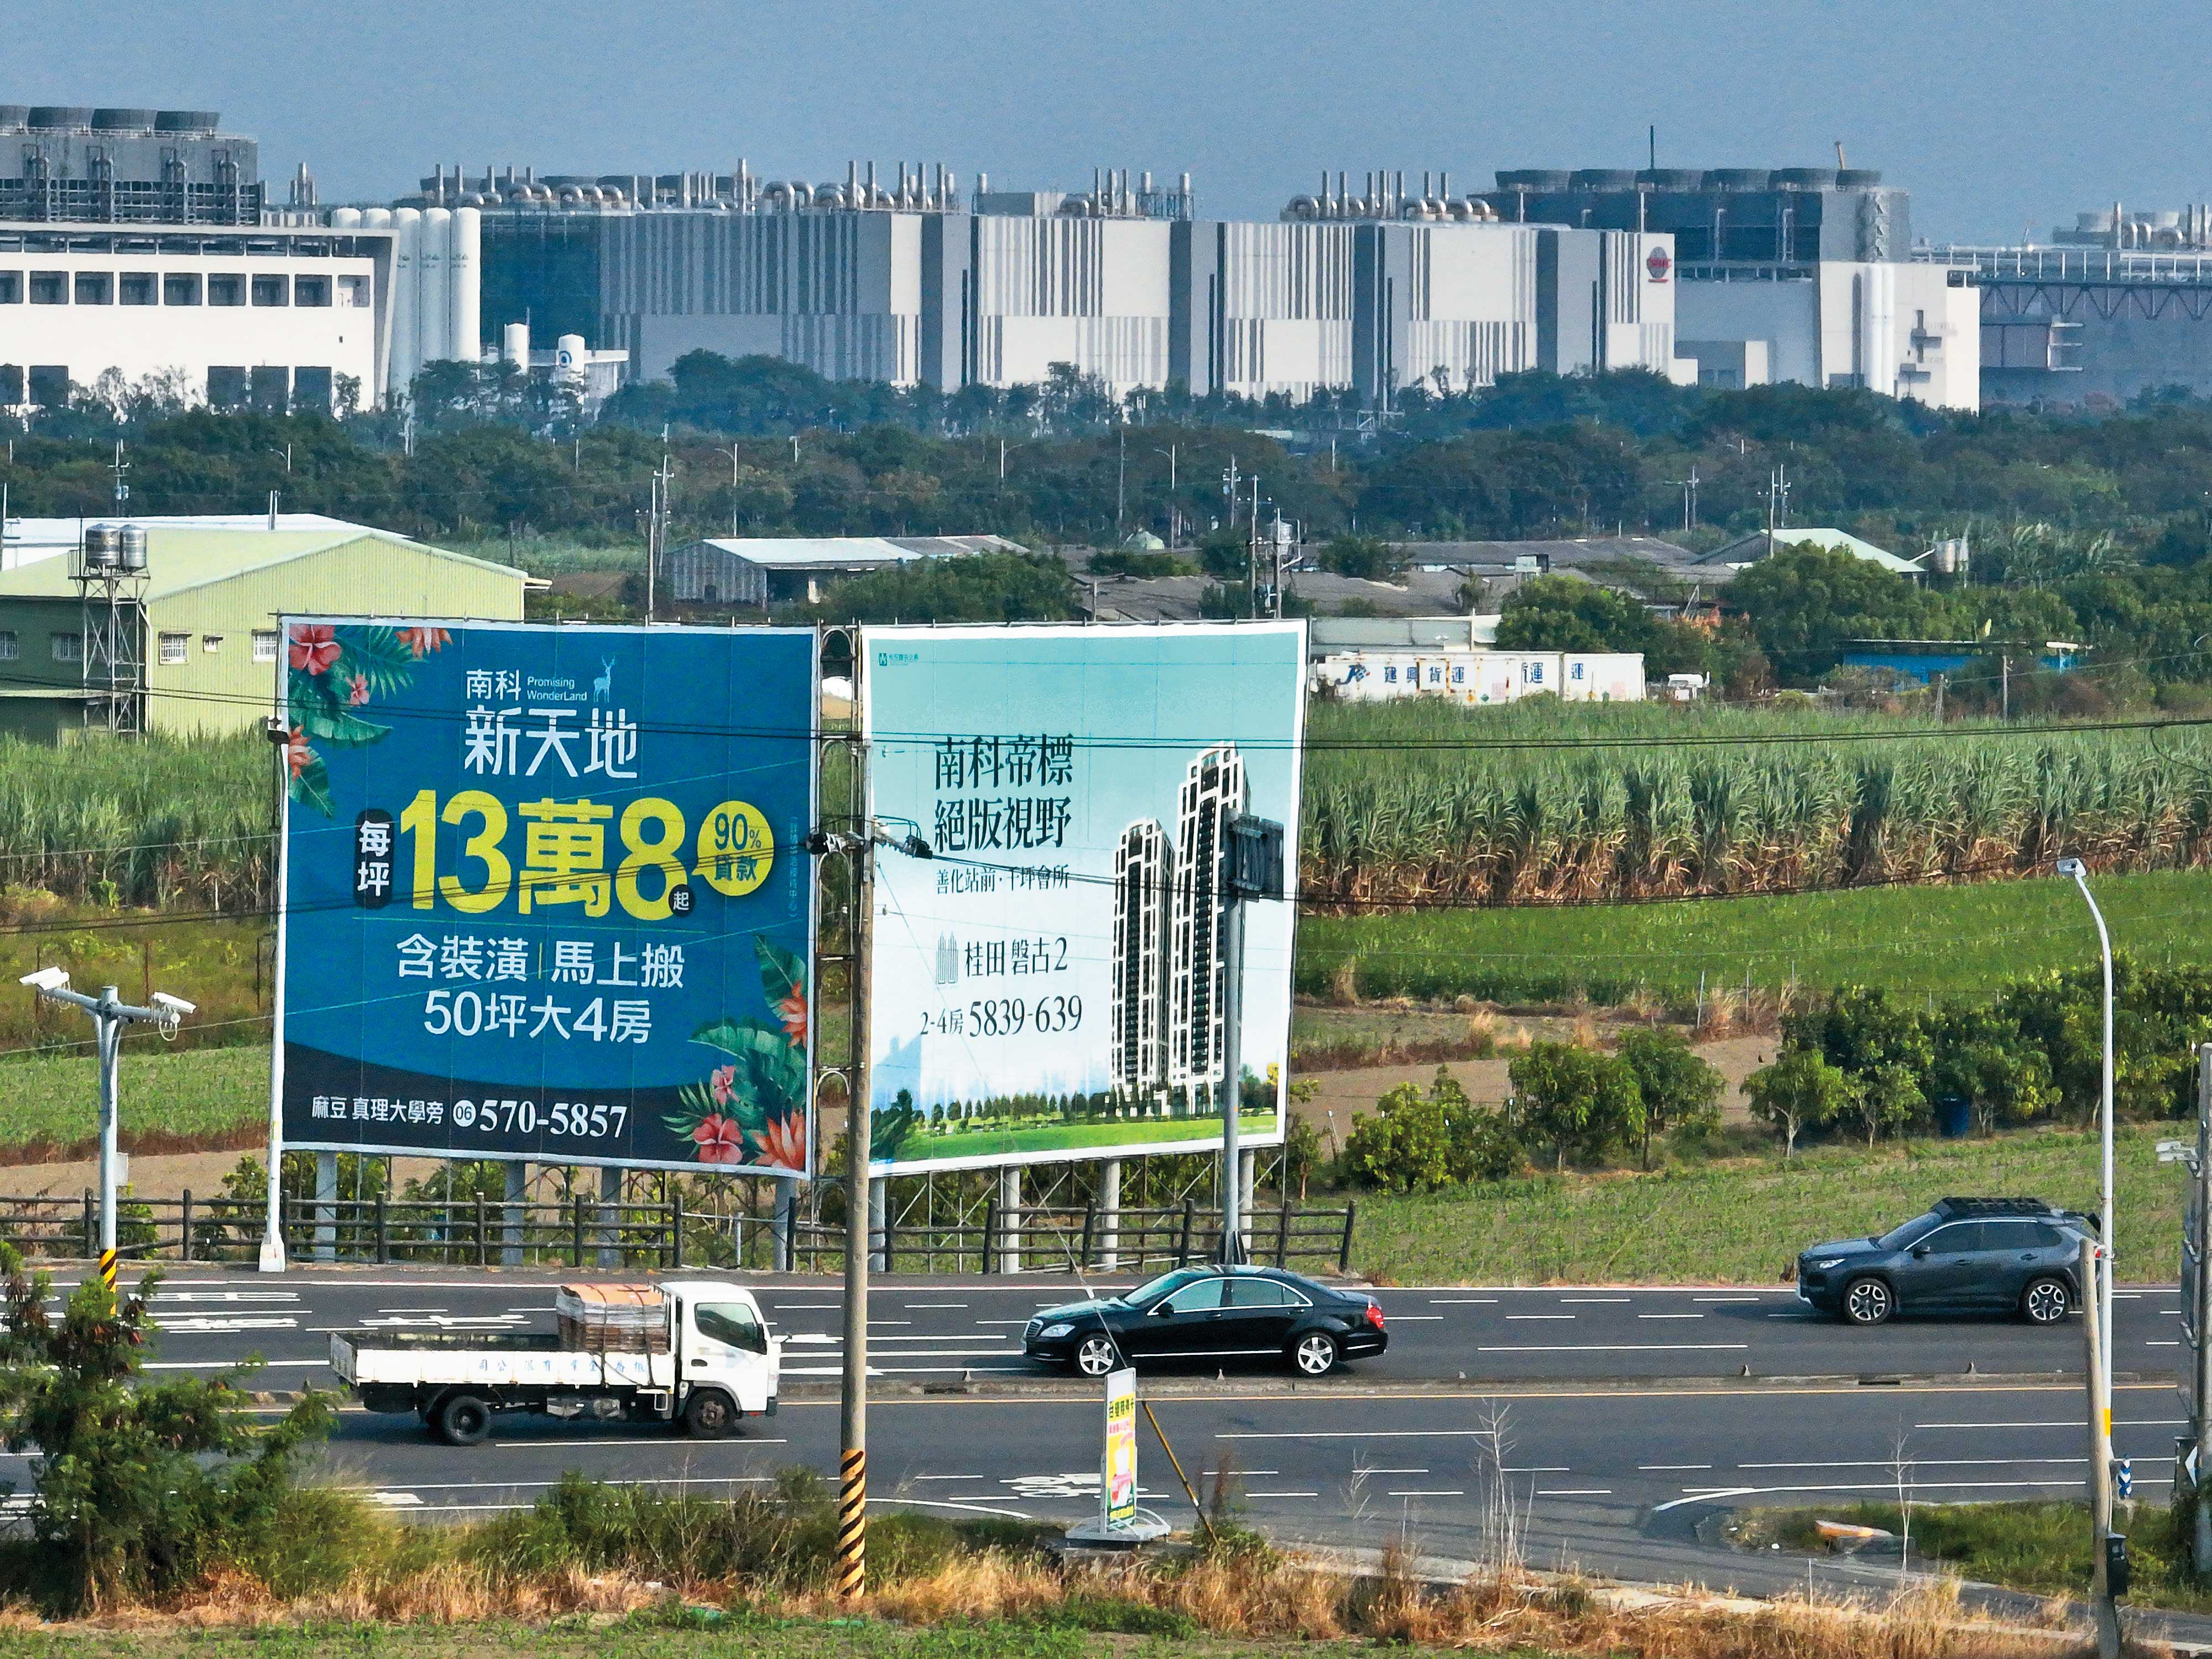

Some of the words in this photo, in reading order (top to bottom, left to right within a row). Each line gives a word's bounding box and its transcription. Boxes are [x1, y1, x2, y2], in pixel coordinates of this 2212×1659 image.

[466, 669, 521, 701] 南科
[527, 676, 575, 690] Promising
[527, 690, 587, 701] WonderLand
[464, 705, 638, 779] 新天地
[935, 733, 1073, 791] 南科帝標
[714, 813, 763, 852] 90%
[934, 795, 1072, 853] 絕版視野
[357, 820, 393, 898] 每坪
[400, 789, 686, 921] 13萬8
[673, 890, 691, 912] 起
[713, 853, 758, 883] 貸款
[396, 932, 529, 984] 含裝潢
[551, 940, 685, 990] 馬上搬
[423, 990, 653, 1044] 50坪大4房
[920, 1008, 964, 1036] 2-4房
[969, 995, 1083, 1037] 5839-639
[312, 1095, 348, 1119] 麻豆
[352, 1097, 444, 1125] 真理大學旁
[479, 1099, 628, 1139] 570-5857
